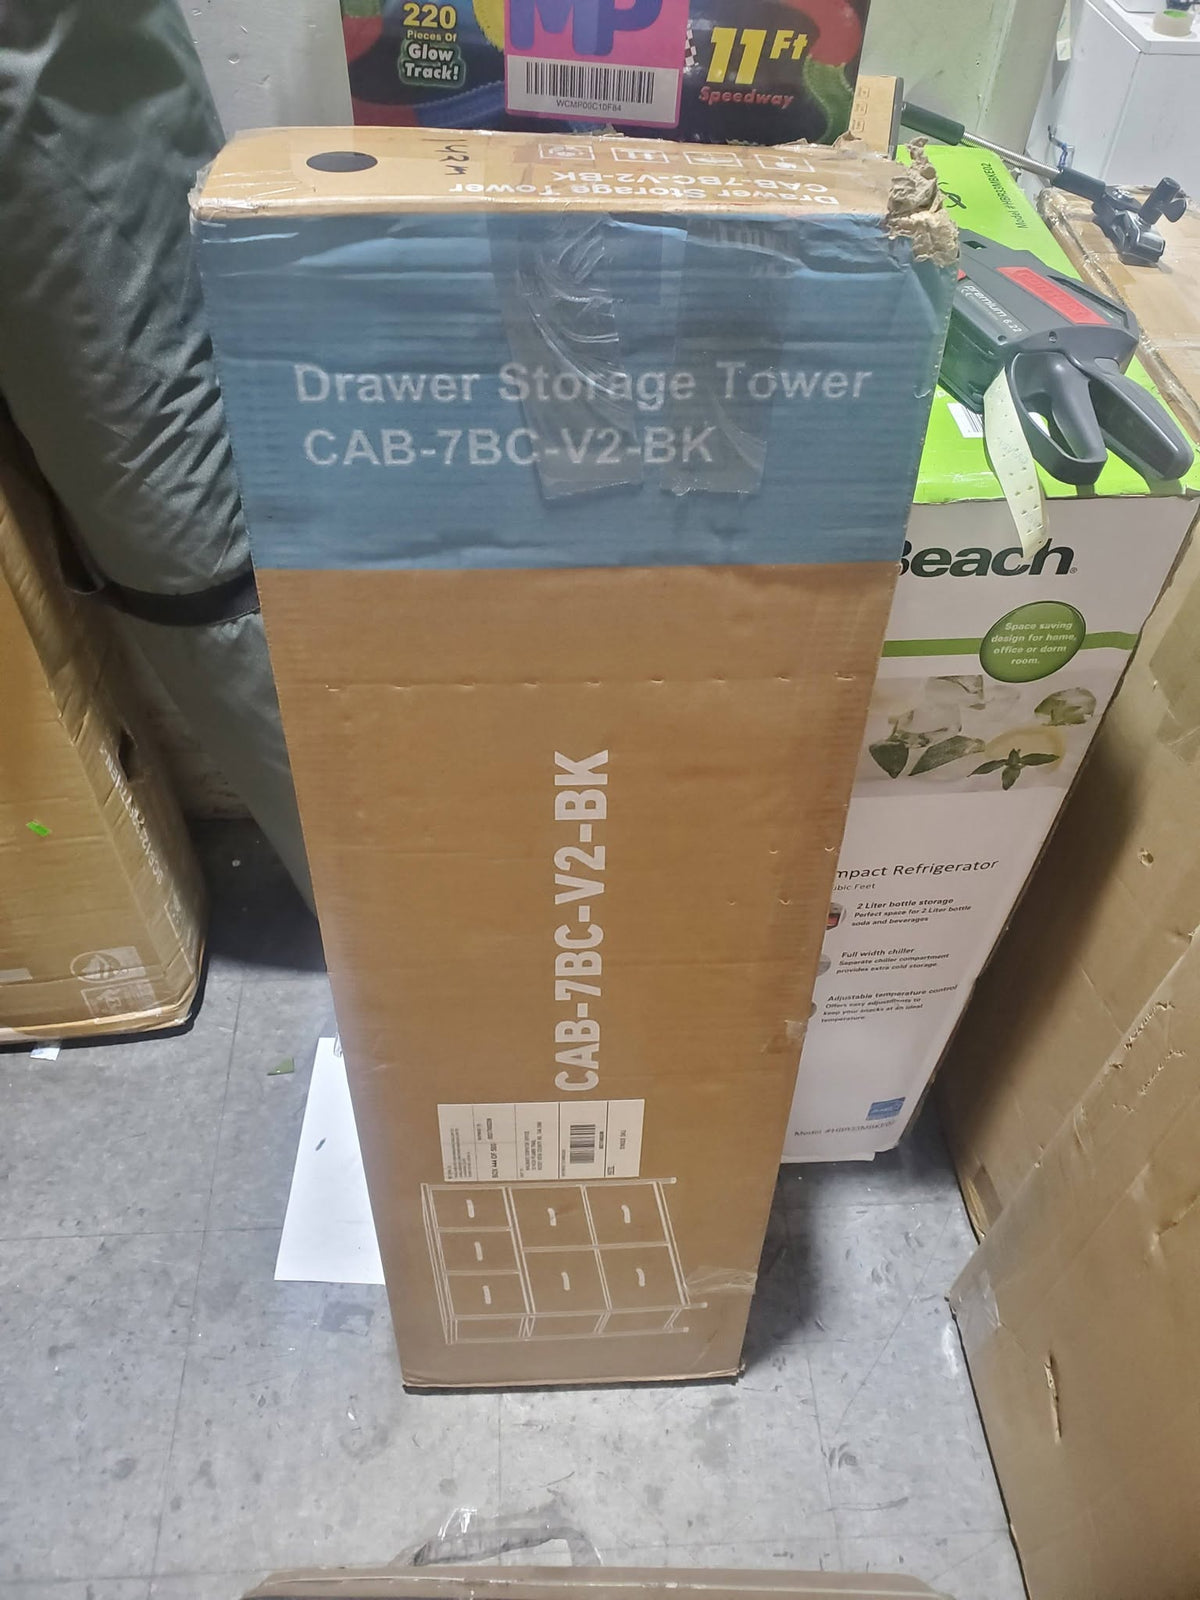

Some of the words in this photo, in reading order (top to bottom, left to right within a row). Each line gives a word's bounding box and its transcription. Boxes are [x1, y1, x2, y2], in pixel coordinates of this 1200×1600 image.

[402, 3, 458, 29] 220
[407, 29, 442, 40] Pieces
[444, 33, 457, 42] Of
[408, 43, 454, 62] Glow
[706, 27, 767, 85] 11
[769, 30, 809, 60] Ft
[404, 62, 459, 81] Track!
[700, 86, 794, 109] Speedway
[448, 183, 561, 196] Tower
[551, 170, 829, 193] CAB-7BC-V2-BK
[572, 183, 708, 199] Storage
[717, 188, 840, 205] Drawer
[963, 285, 1008, 317] premium
[293, 362, 480, 402] Drawer
[499, 361, 697, 411] Storage
[715, 359, 872, 400] Tower
[302, 423, 718, 467] CAB-7BC-V2-BK
[1005, 622, 1037, 632] Space
[1039, 621, 1073, 631] saving
[991, 634, 1025, 643] design
[1028, 634, 1044, 642] for
[993, 645, 1025, 654] office
[1040, 645, 1067, 653] dorm
[893, 860, 1000, 876] Refrigerator
[865, 901, 887, 909] Liter
[889, 900, 917, 908] bottle
[919, 898, 954, 906] storage
[554, 749, 609, 1092] CAB-7BC-V2-BK
[889, 916, 929, 924] beverages
[839, 959, 873, 967] Separate
[898, 953, 950, 962] compartment
[860, 949, 886, 957] width
[836, 967, 869, 975] provides
[828, 993, 873, 1002] Adjustable
[875, 989, 927, 999] temperature
[928, 984, 959, 994] control
